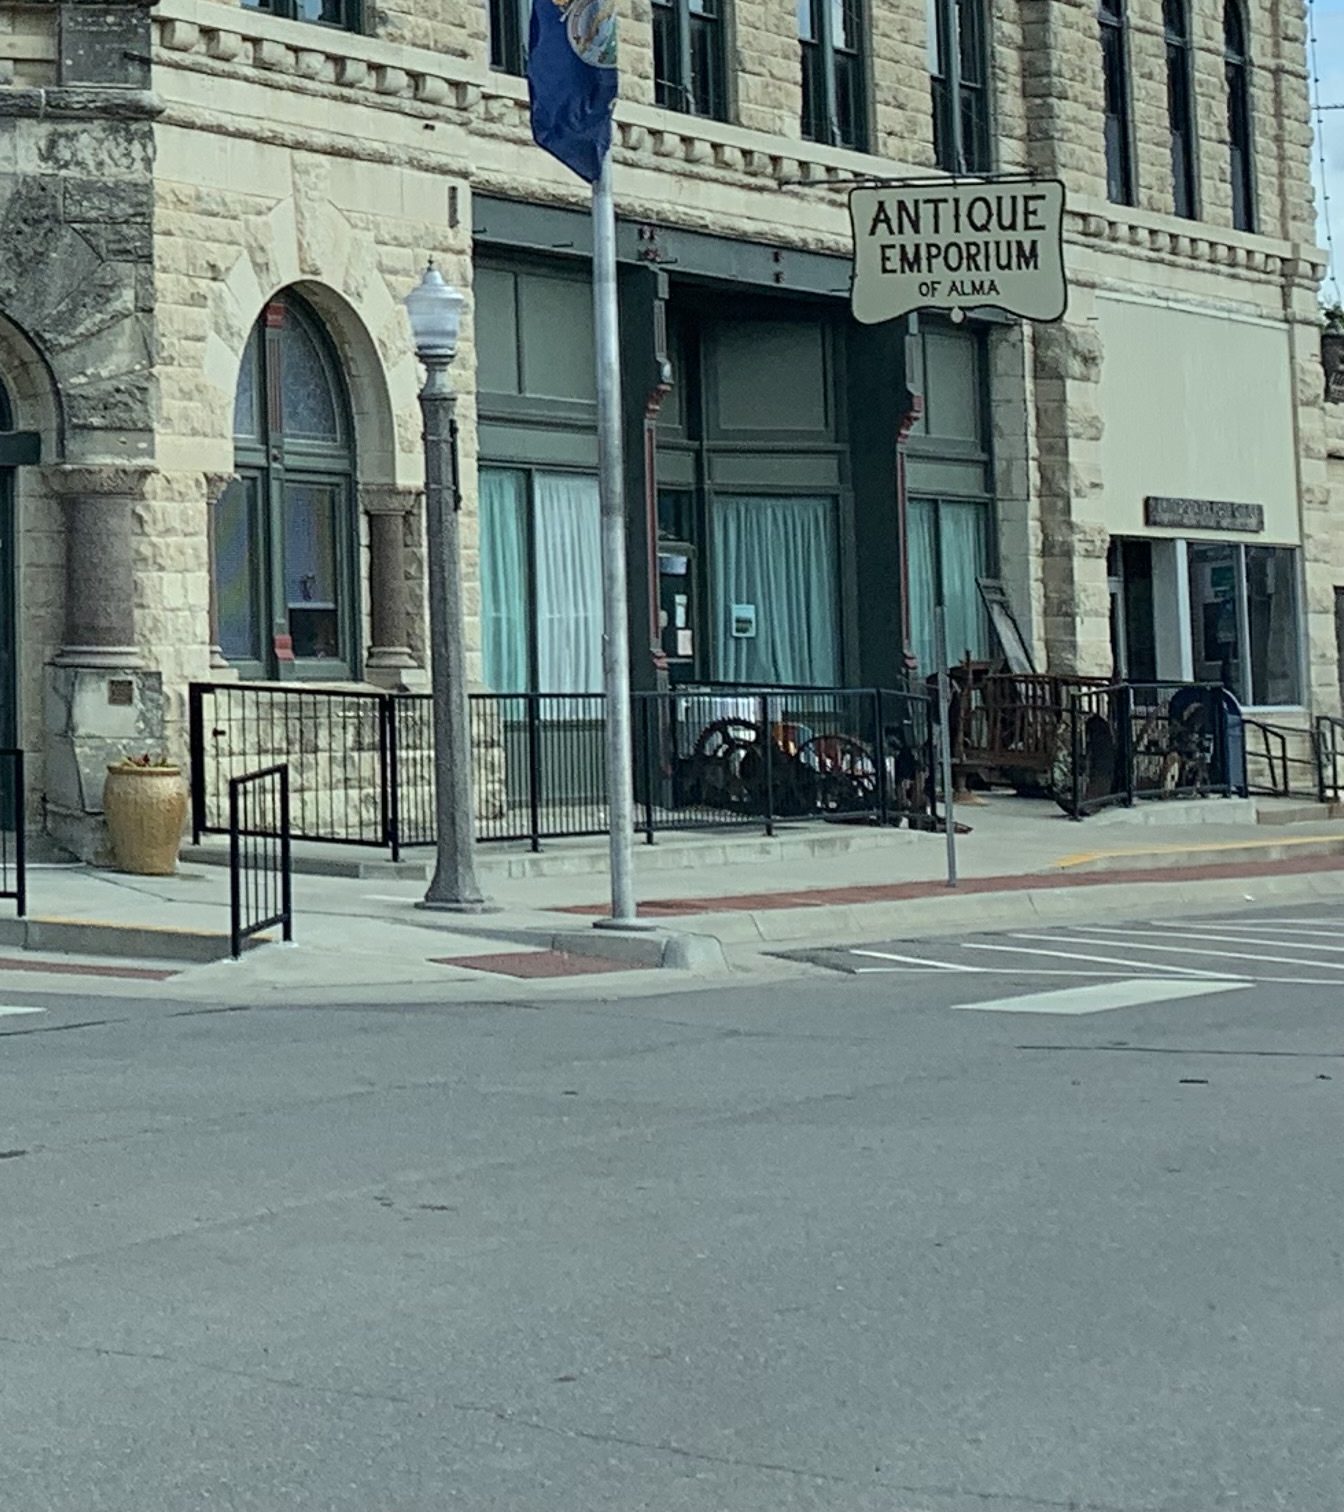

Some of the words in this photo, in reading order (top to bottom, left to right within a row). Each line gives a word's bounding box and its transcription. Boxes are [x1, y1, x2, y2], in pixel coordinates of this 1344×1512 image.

[868, 194, 1047, 236] ANTIQUE
[879, 240, 1039, 274] EMPORIUM
[918, 280, 942, 297] OF
[947, 279, 1000, 296] ALMA
